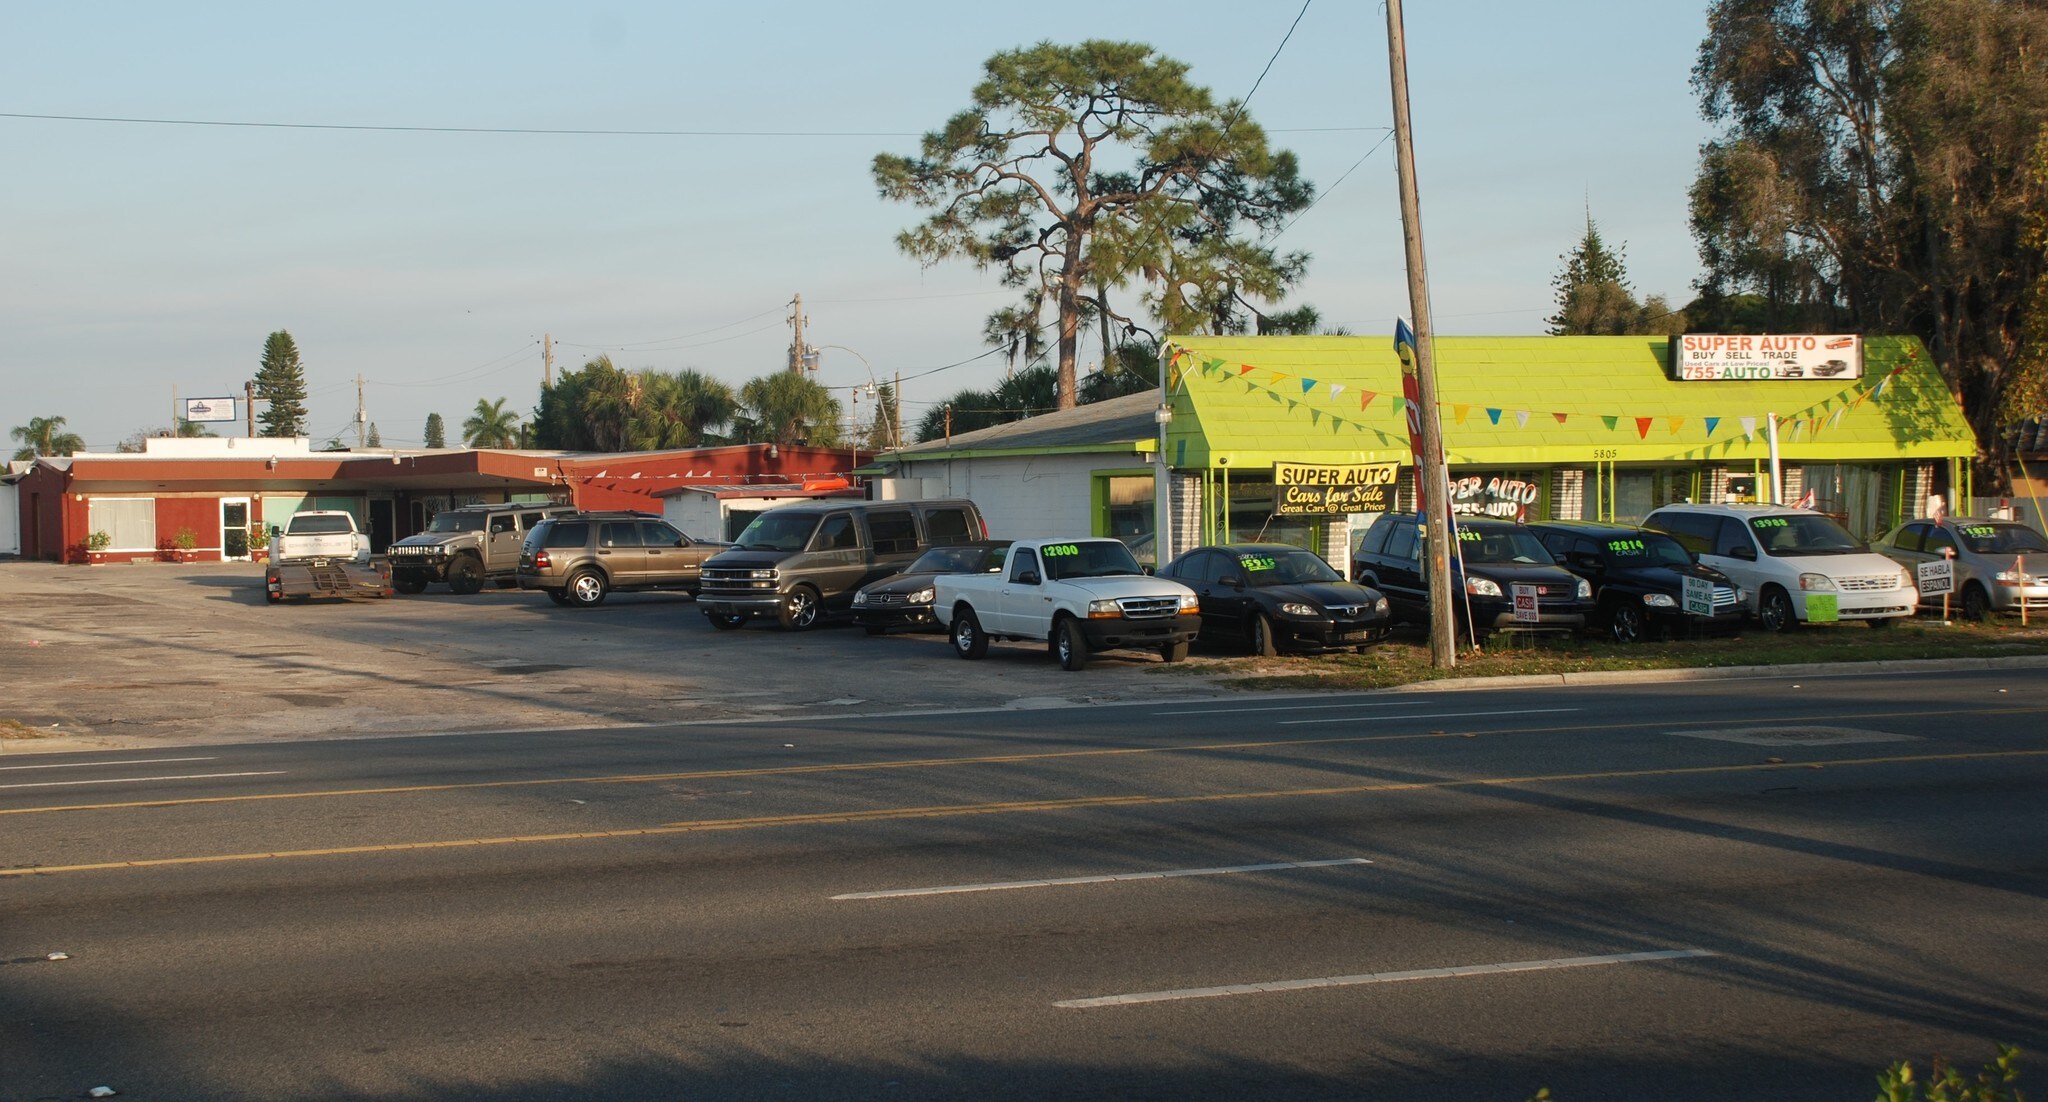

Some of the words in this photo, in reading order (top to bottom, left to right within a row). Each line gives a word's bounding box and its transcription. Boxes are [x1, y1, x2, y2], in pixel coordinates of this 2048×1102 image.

[1684, 337, 1753, 351] SUPER
[1759, 337, 1817, 351] AUTO
[1692, 351, 1715, 359] BUY
[1726, 351, 1752, 359] SELL
[1763, 351, 1797, 359] TRADE
[1683, 366, 1771, 379] 755-AUTO
[1593, 449, 1617, 459] 5805
[1282, 468, 1340, 485] SUPER
[1344, 467, 1391, 484] AUTO
[1286, 486, 1320, 503] Cars
[1325, 486, 1349, 508] for
[1352, 485, 1384, 502] Sale
[1449, 476, 1484, 500] PER
[1486, 477, 1537, 505] AUTO
[1280, 503, 1303, 513] Great
[1306, 503, 1325, 513] Cars
[1327, 503, 1338, 514] @
[1340, 503, 1362, 513] Great
[1364, 502, 1386, 511] Prices
[1043, 545, 1079, 557] $2800
[1920, 566, 1929, 577] SE
[1929, 563, 1951, 576] HABLA
[1697, 579, 1708, 589] DAY
[1517, 597, 1534, 609] CASH
